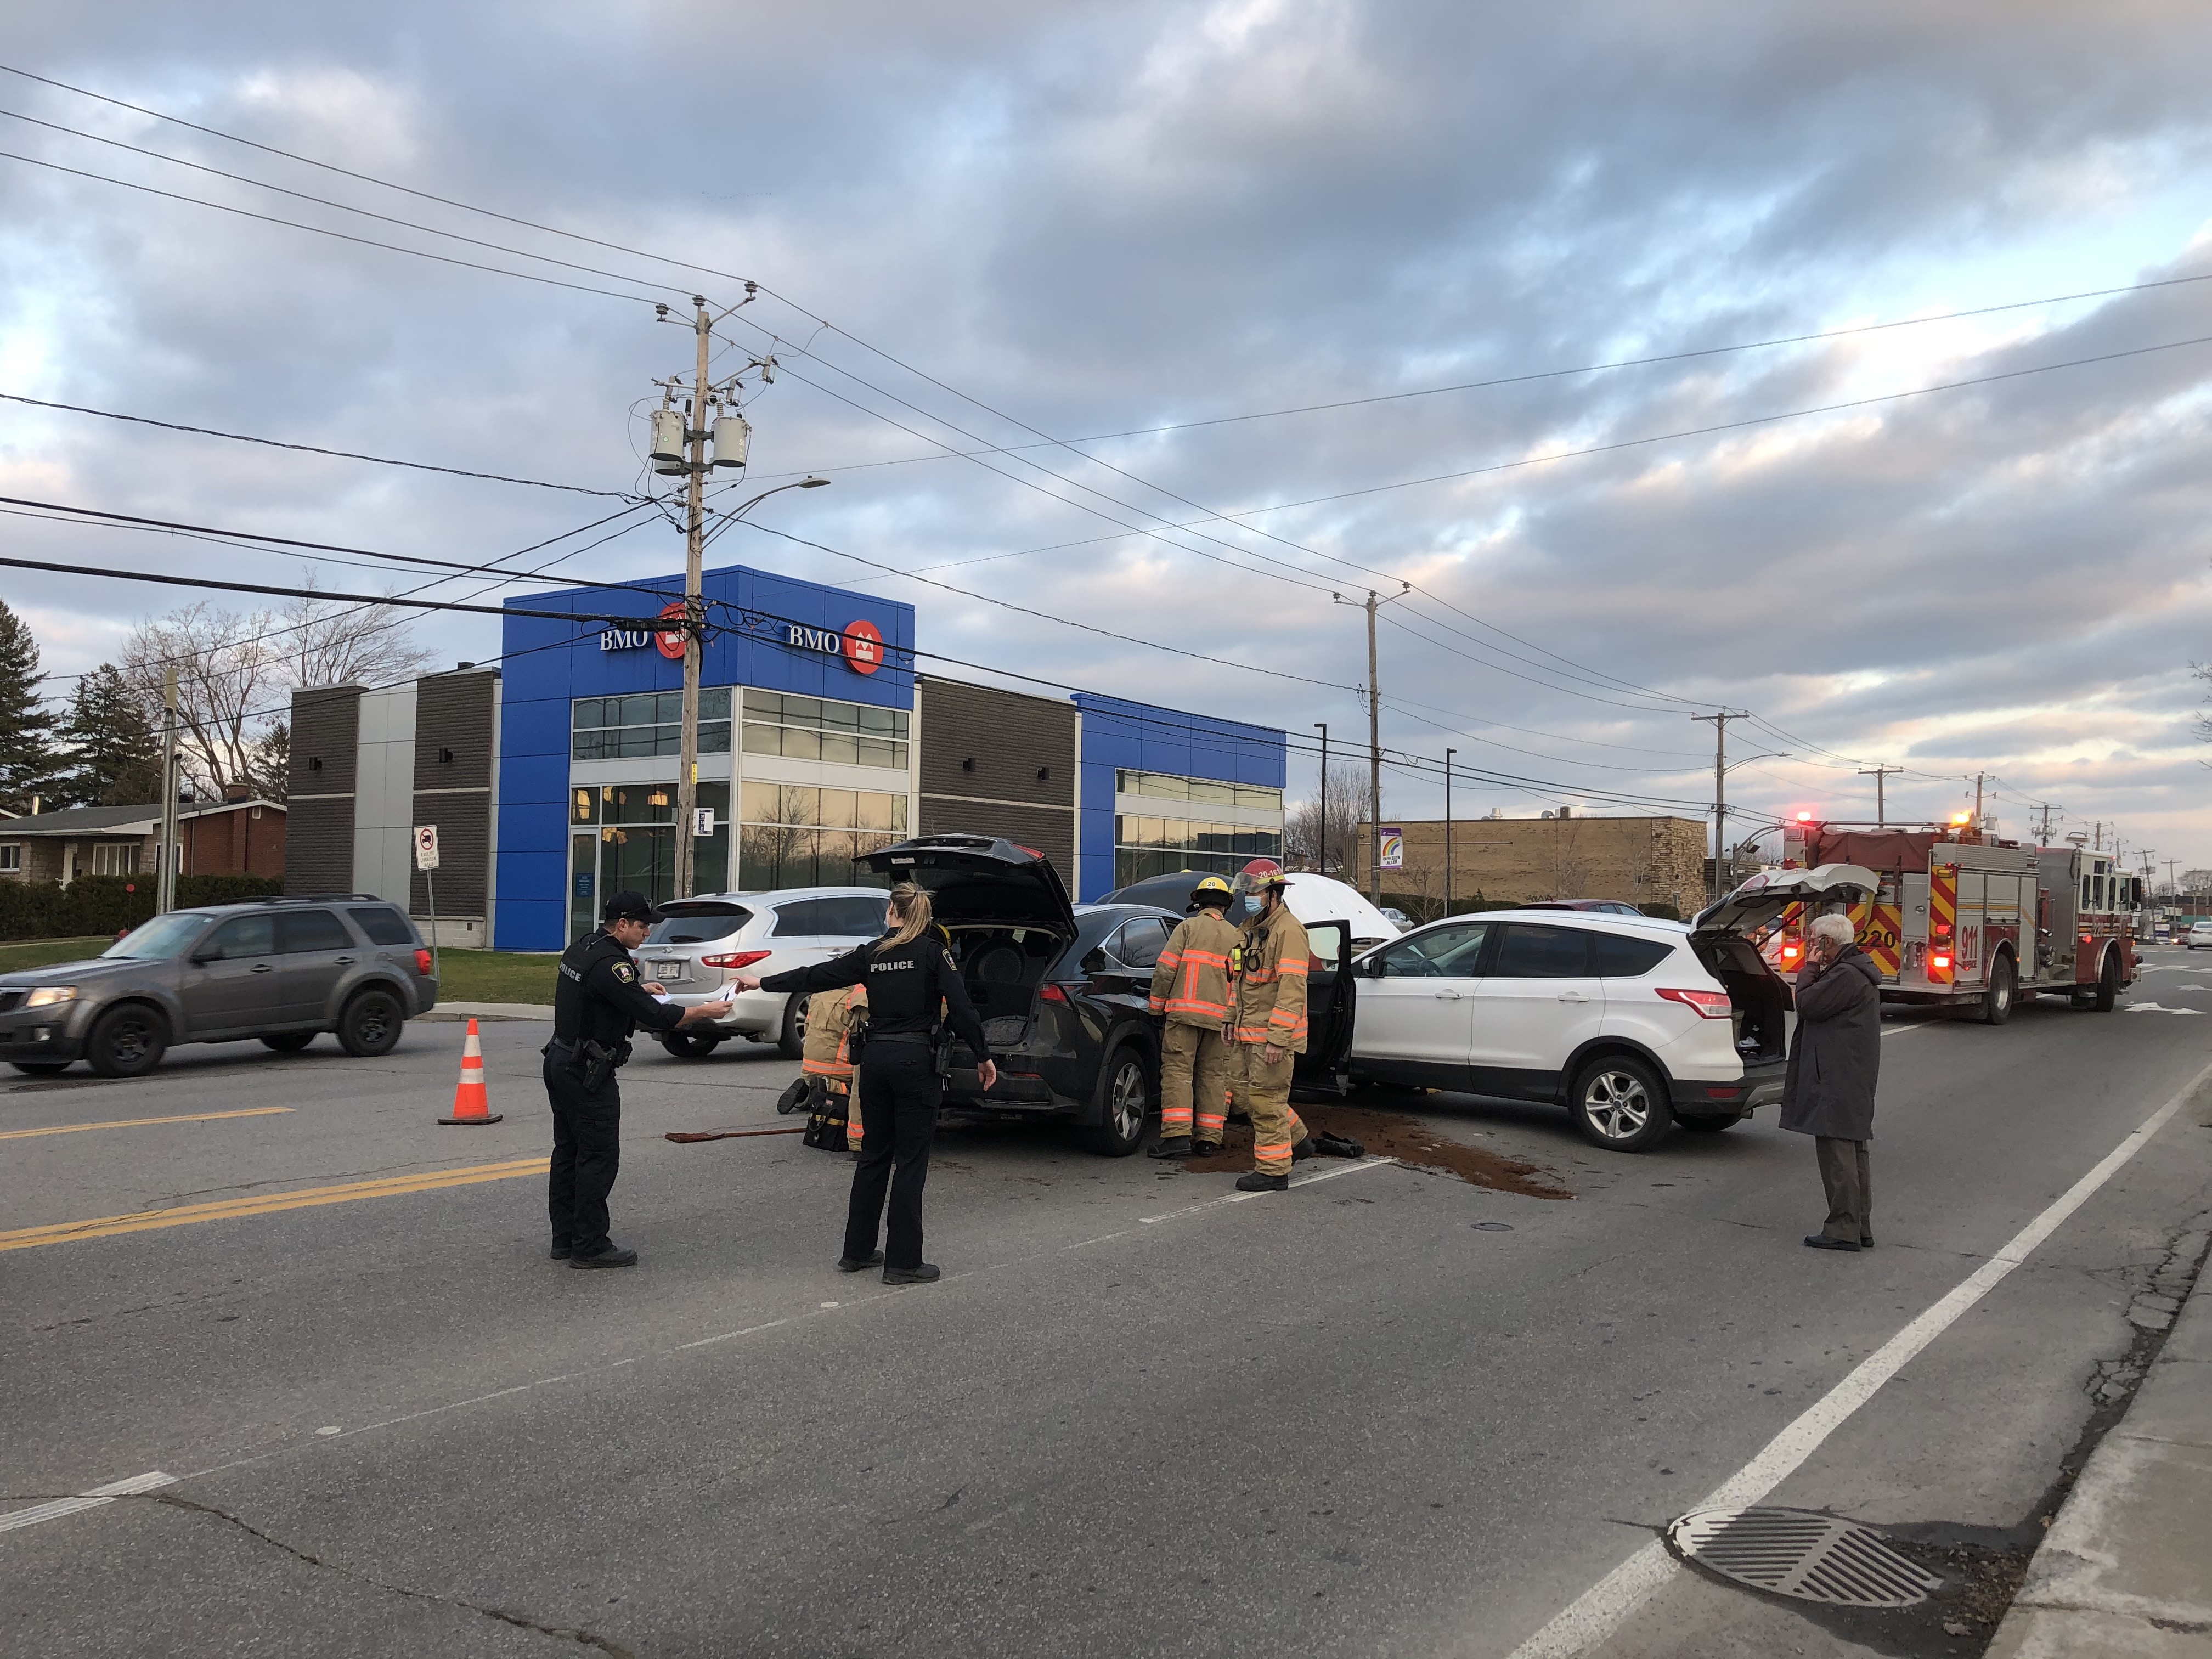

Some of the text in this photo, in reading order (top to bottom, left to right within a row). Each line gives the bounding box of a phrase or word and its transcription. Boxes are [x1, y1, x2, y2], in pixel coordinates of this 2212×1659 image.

[599, 629, 648, 651] BMO
[788, 625, 840, 654] BMO
[1258, 868, 1281, 879] 20-161
[1857, 929, 1896, 948] 220
[1962, 926, 1978, 959] 911
[560, 961, 582, 982] POLICE
[870, 960, 915, 972] POLICE
